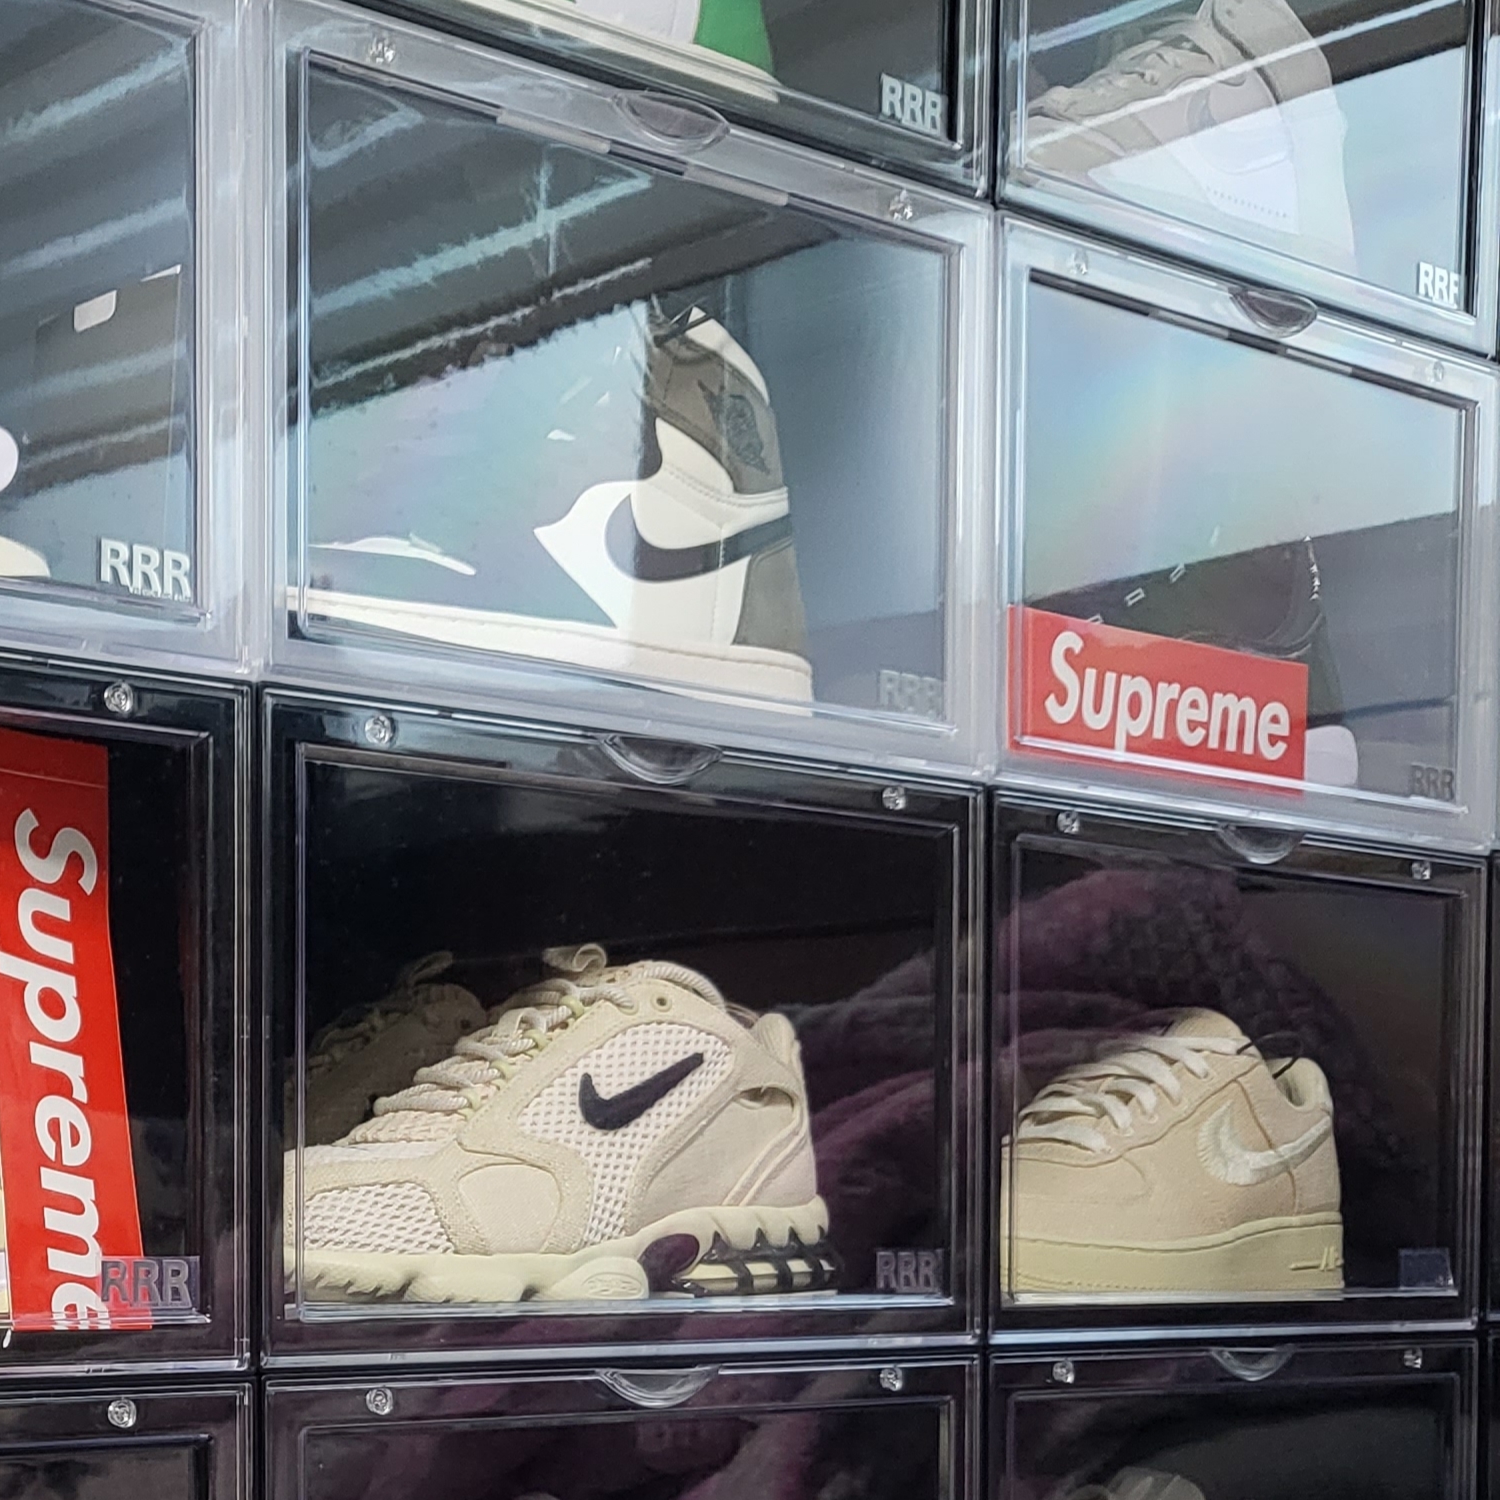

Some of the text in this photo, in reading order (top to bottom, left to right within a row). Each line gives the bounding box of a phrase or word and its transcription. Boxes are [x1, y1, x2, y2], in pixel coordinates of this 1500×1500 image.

[881, 72, 941, 136] RRR
[100, 536, 192, 601] RRR
[1045, 630, 1290, 762] Supreme
[100, 1259, 193, 1309] RRR
[876, 1251, 939, 1293] RRR
